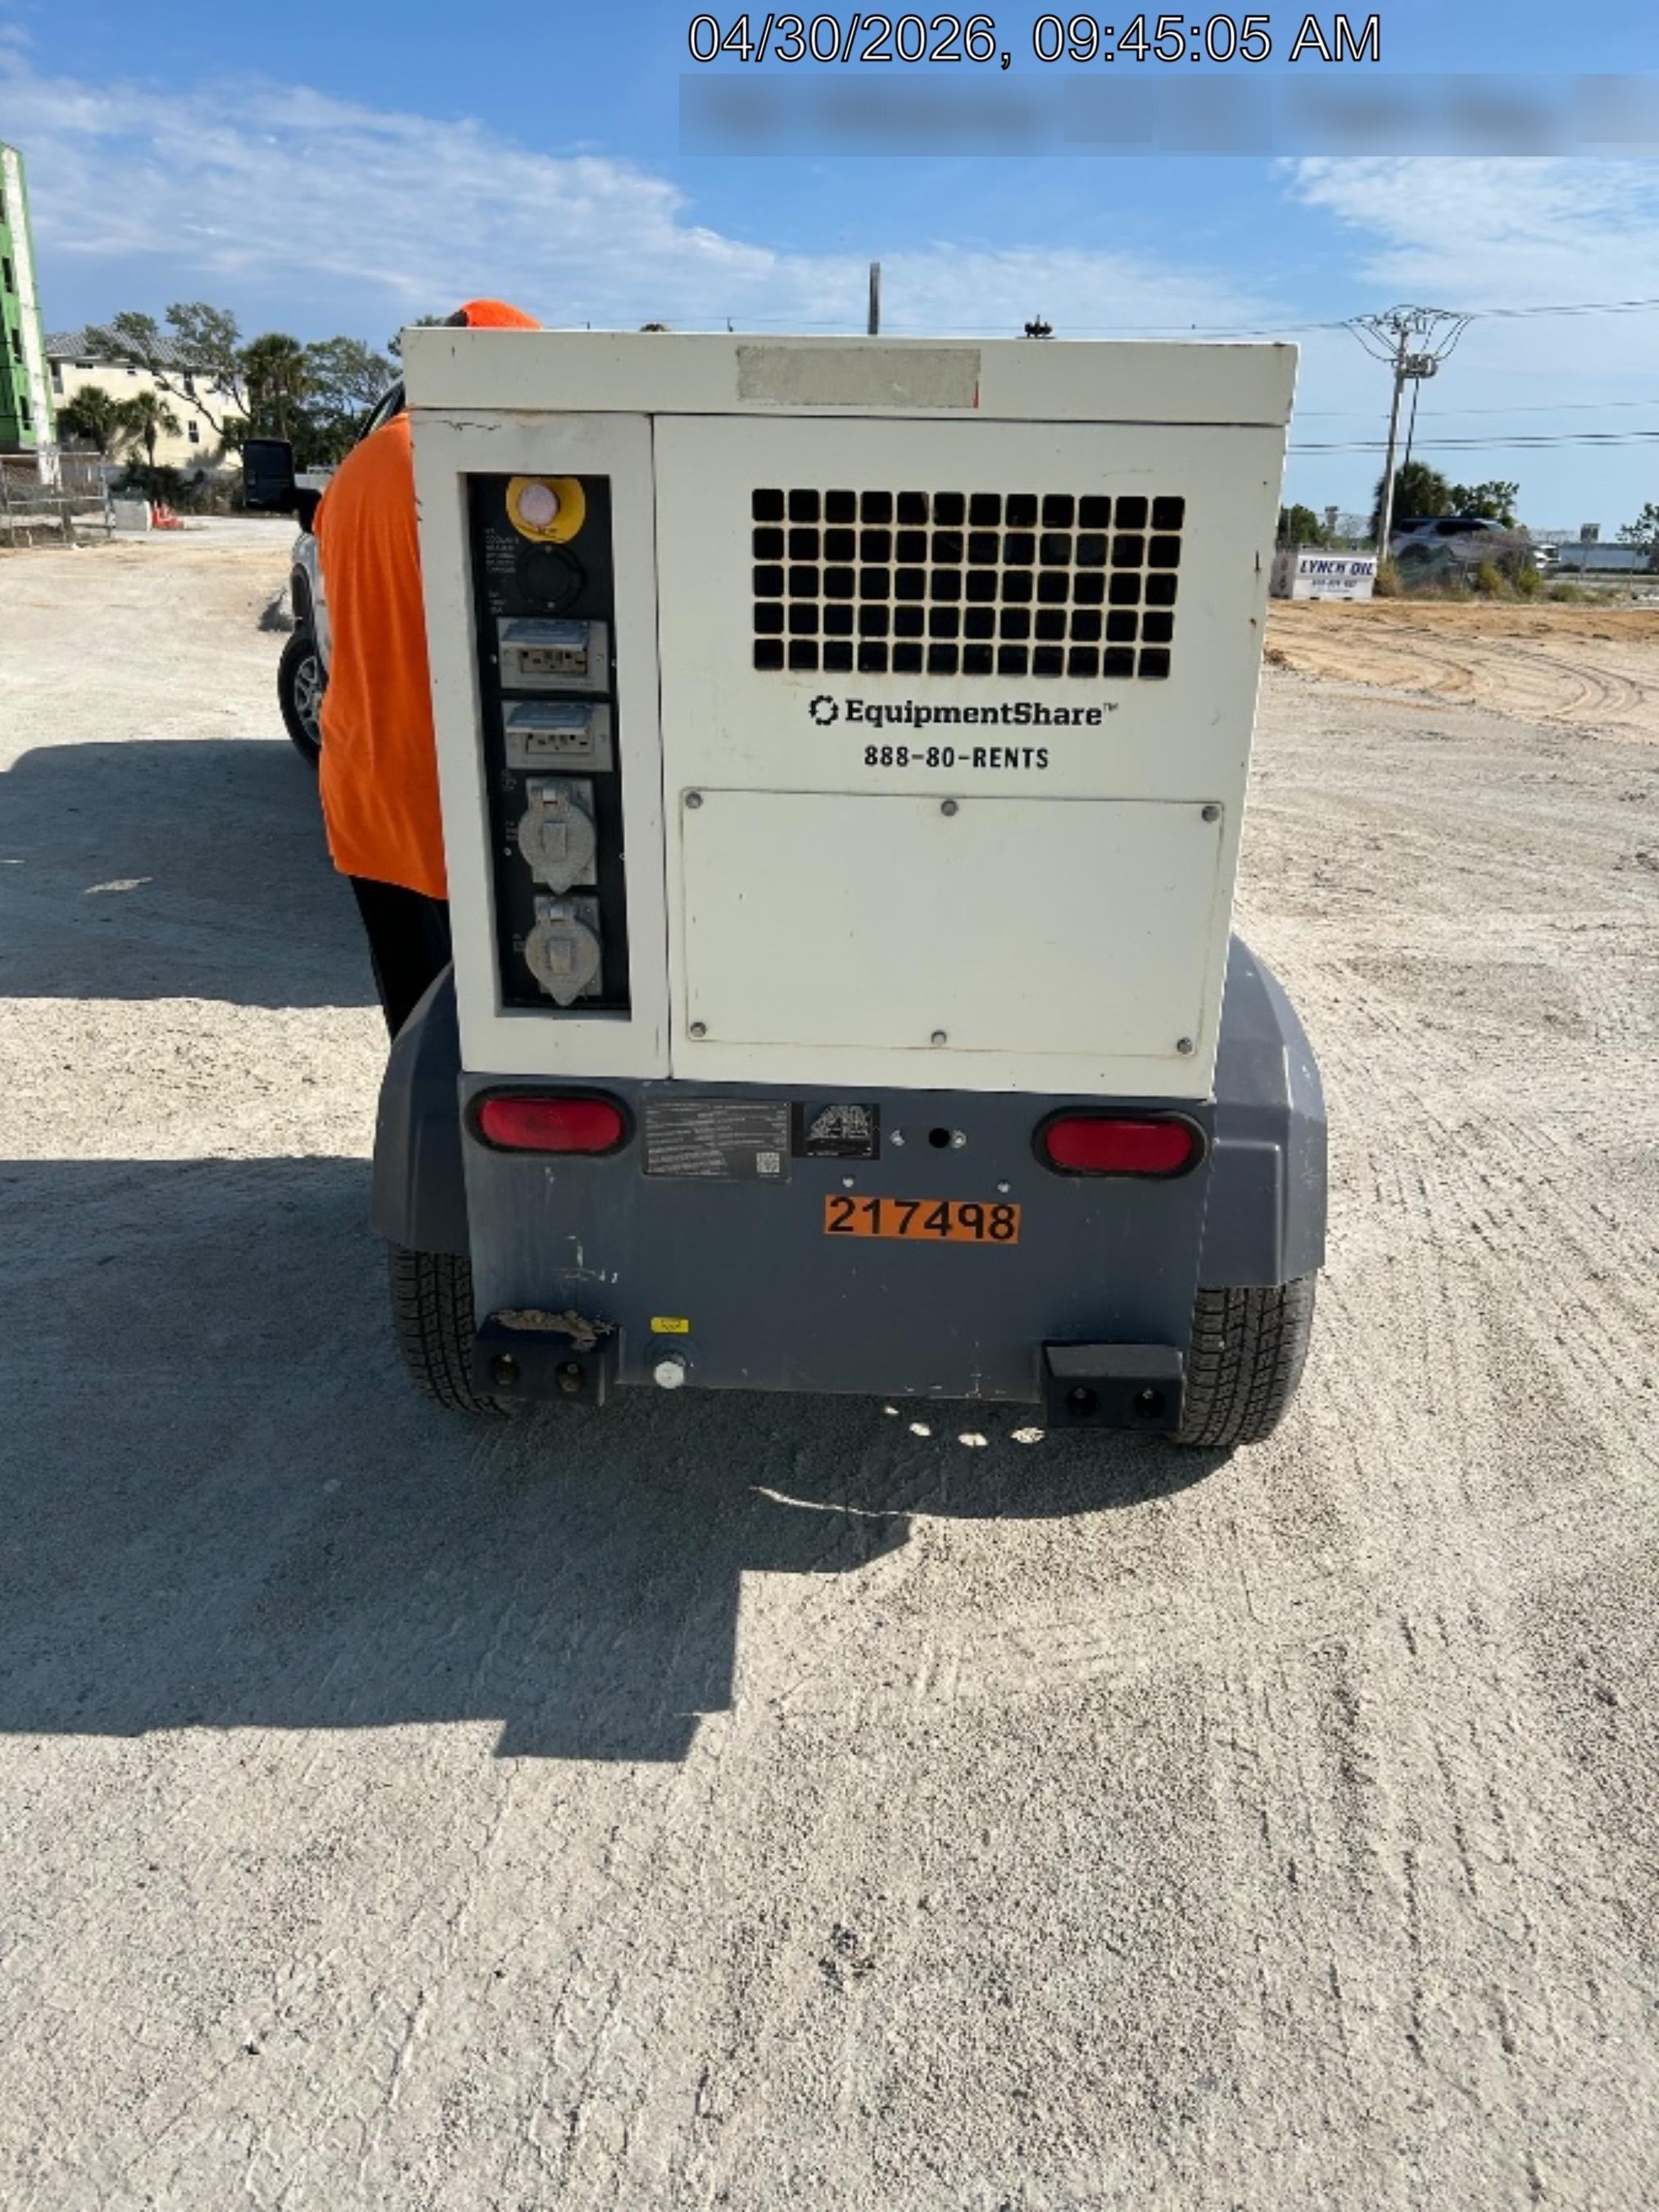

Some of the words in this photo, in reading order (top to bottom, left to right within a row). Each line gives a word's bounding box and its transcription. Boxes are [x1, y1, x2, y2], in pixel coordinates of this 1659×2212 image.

[1300, 560, 1345, 573] LYNCH
[1350, 562, 1374, 575] OIL
[864, 745, 1049, 769] 888-80-RENTS
[827, 1195, 1016, 1240] 217498
